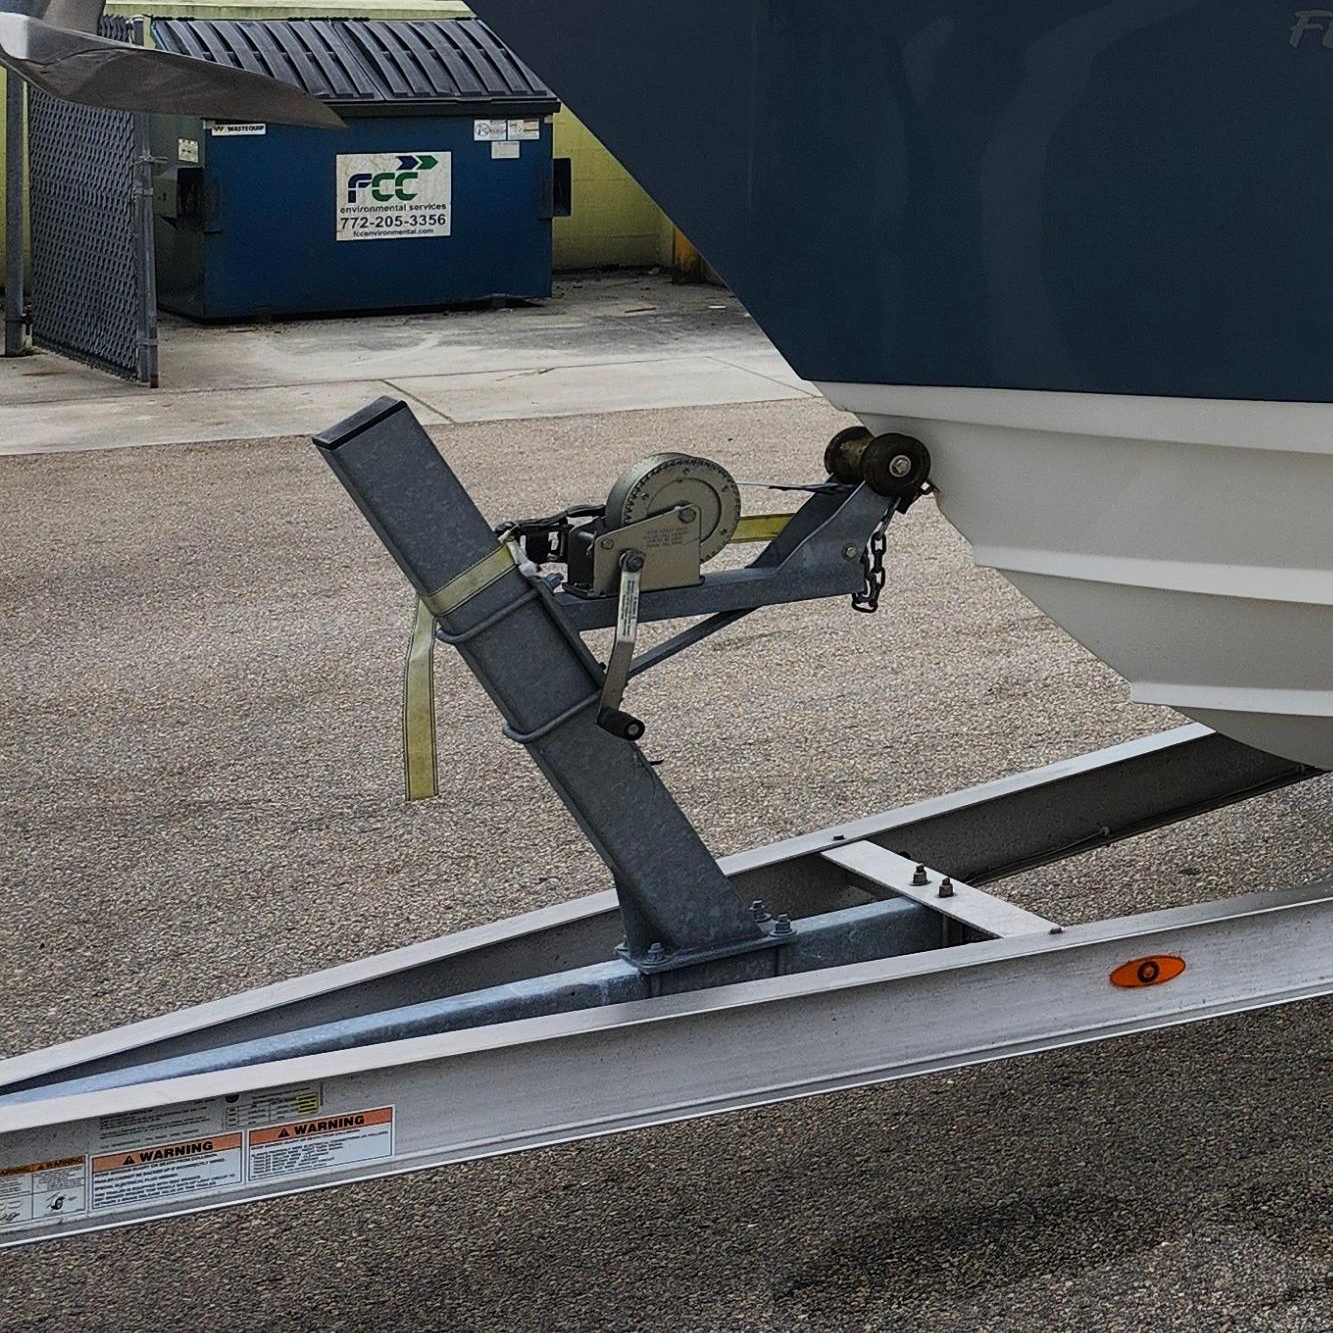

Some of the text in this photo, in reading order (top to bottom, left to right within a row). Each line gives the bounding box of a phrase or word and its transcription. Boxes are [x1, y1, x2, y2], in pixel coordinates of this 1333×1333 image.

[347, 171, 419, 204] FCC
[340, 203, 447, 214] environmental services
[340, 213, 446, 230] 772-205-3356
[353, 228, 434, 238] fccenvironmental.com
[294, 1115, 366, 1135] WARNING
[139, 1140, 214, 1163] WARNING
